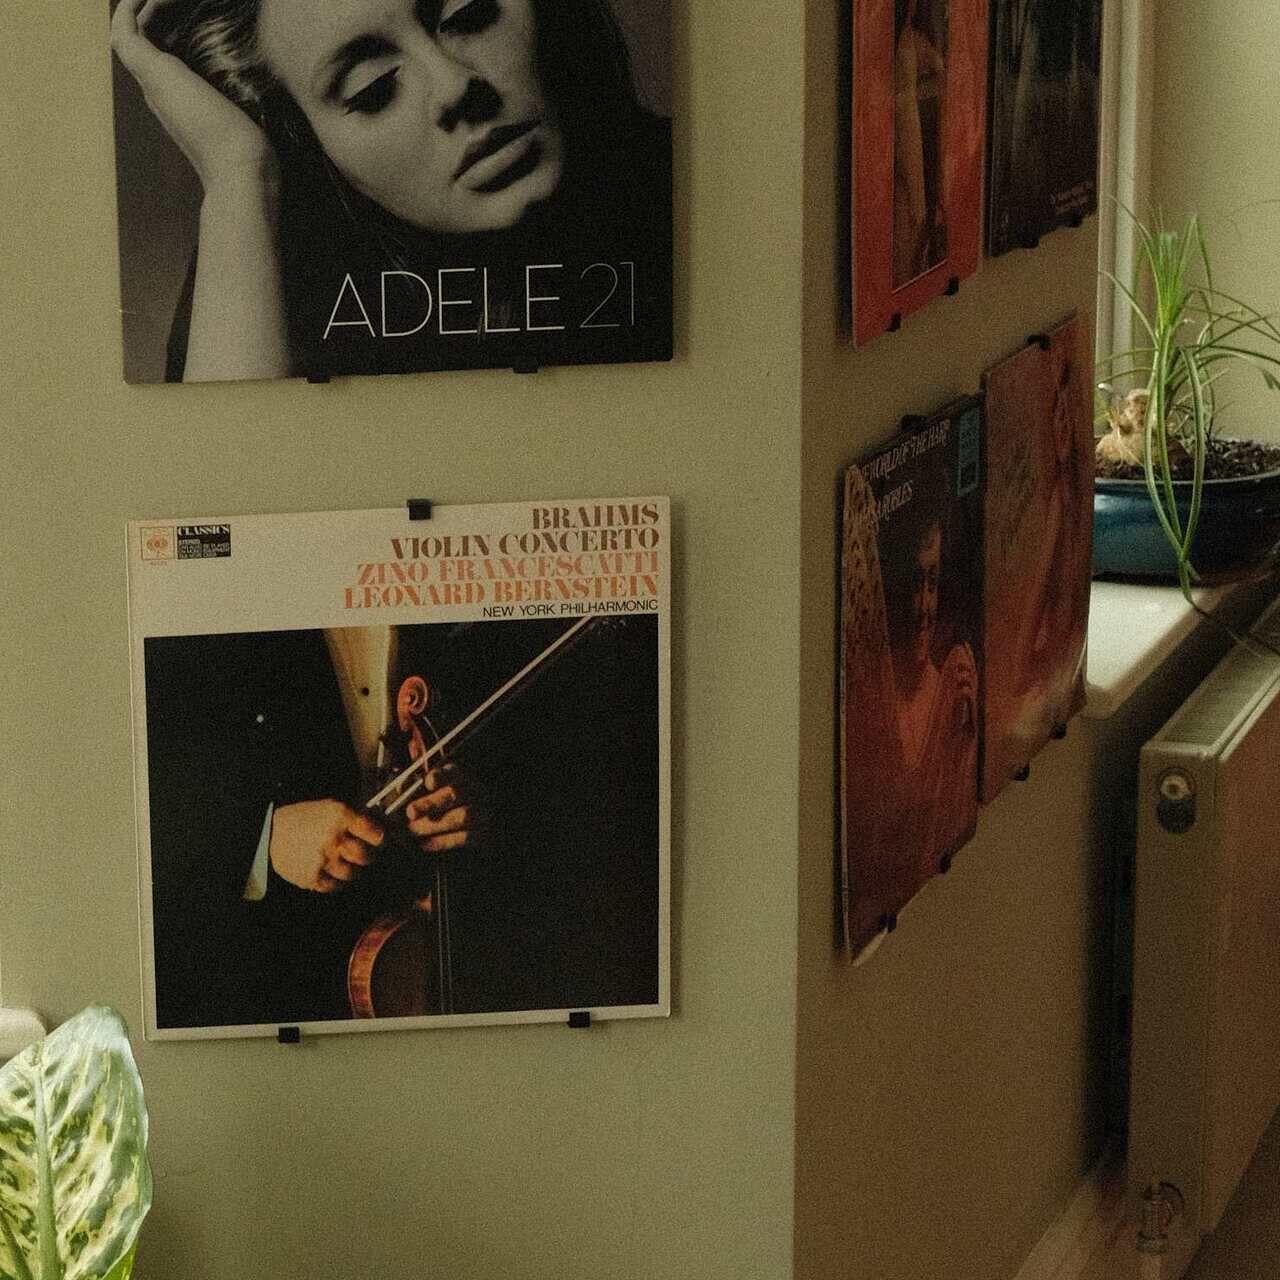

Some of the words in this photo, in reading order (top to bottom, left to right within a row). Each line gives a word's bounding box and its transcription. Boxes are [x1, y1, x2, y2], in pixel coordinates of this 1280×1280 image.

[323, 264, 565, 339] ADELE
[580, 262, 635, 329] 21
[178, 525, 230, 536] CLASSICS
[533, 503, 659, 530] BRAHMS
[391, 534, 490, 560] VIOLIN
[498, 527, 660, 556] CONCERTO
[357, 561, 429, 586] ZINO
[439, 551, 659, 582] FRANCESCATTI
[343, 581, 486, 610] LEONARD
[494, 574, 659, 603] BERNSTEIN
[483, 606, 517, 618] NEW
[520, 603, 554, 616] YORK
[560, 599, 659, 614] PHILHARMONIC
